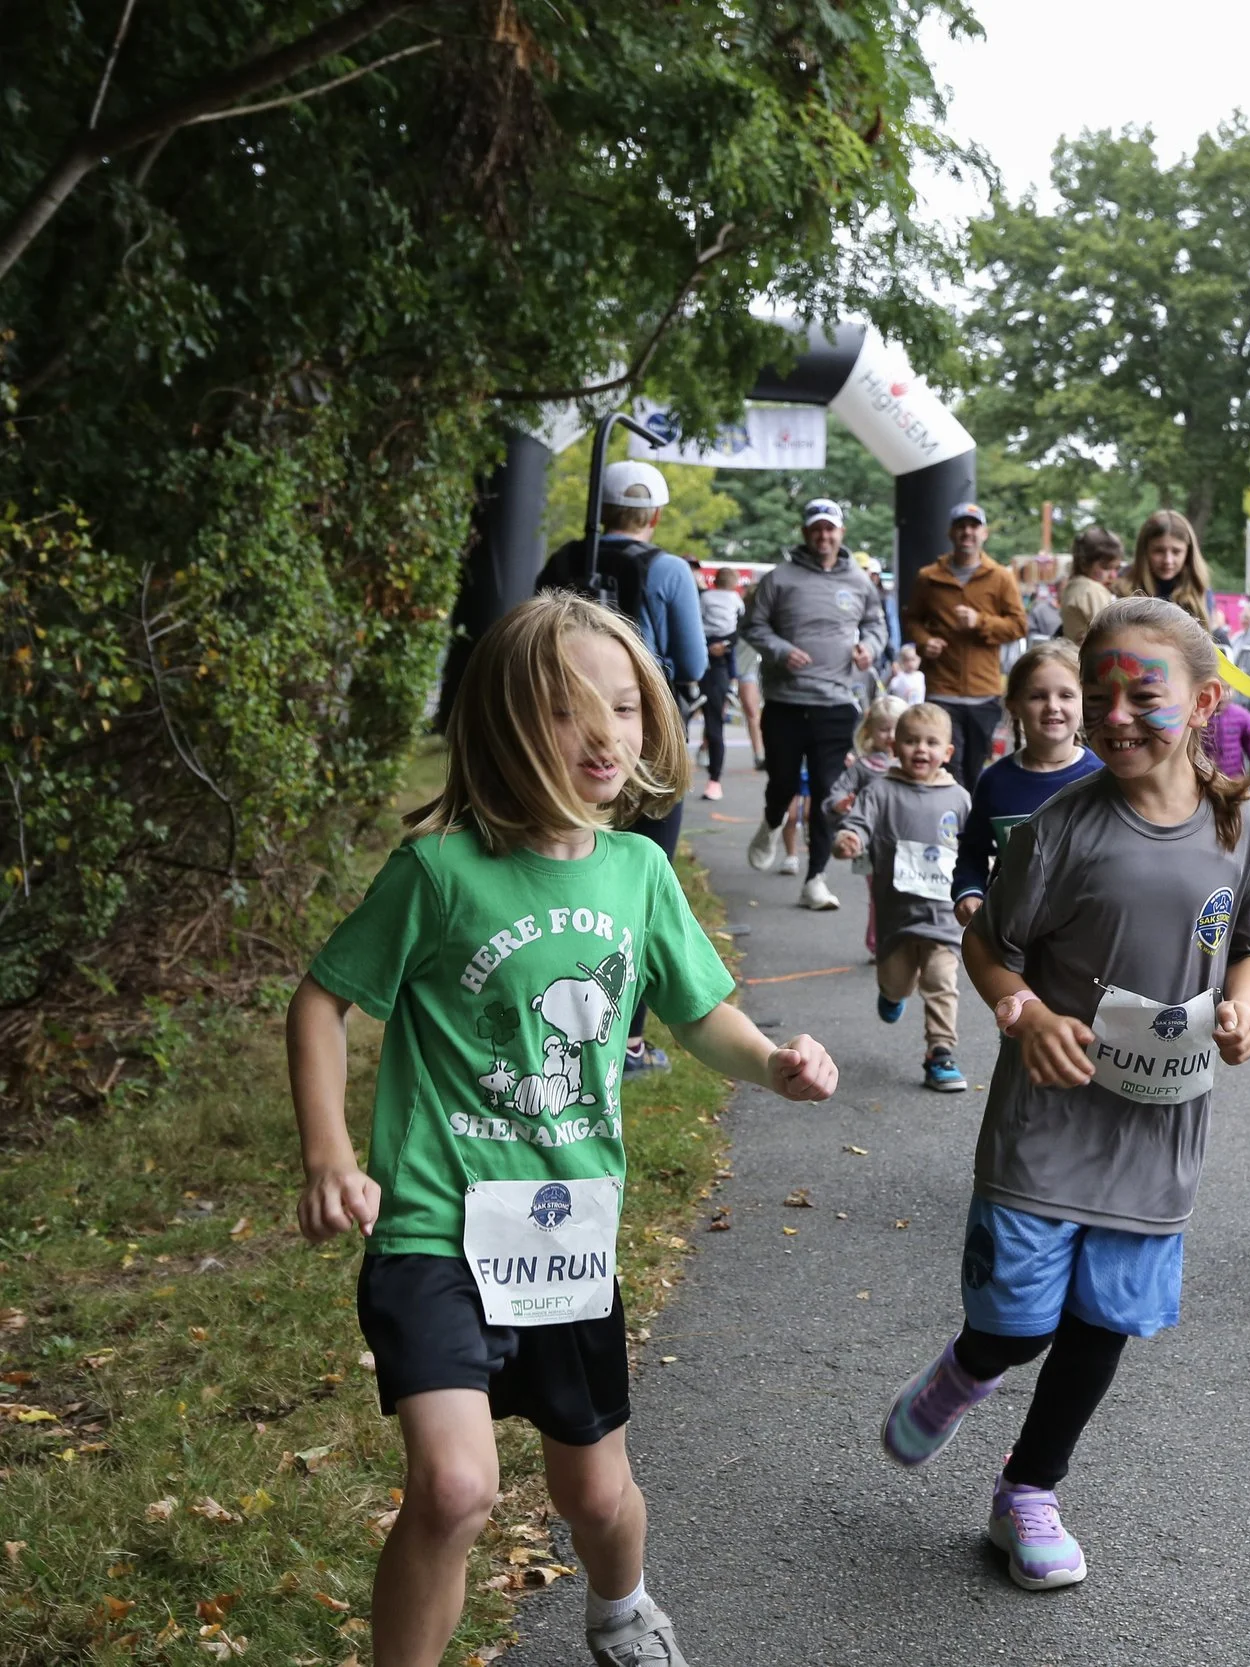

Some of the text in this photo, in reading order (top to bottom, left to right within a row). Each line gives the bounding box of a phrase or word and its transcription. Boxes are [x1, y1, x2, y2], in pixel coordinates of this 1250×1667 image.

[460, 914, 542, 995] HERE
[549, 907, 614, 941] FOR
[1096, 1043, 1210, 1077] FUN RUN
[1135, 1084, 1181, 1095] DUFFY
[449, 1112, 622, 1147] SHENANIGAN
[477, 1251, 606, 1285] FUN RUN
[523, 1295, 574, 1310] DUFFY
